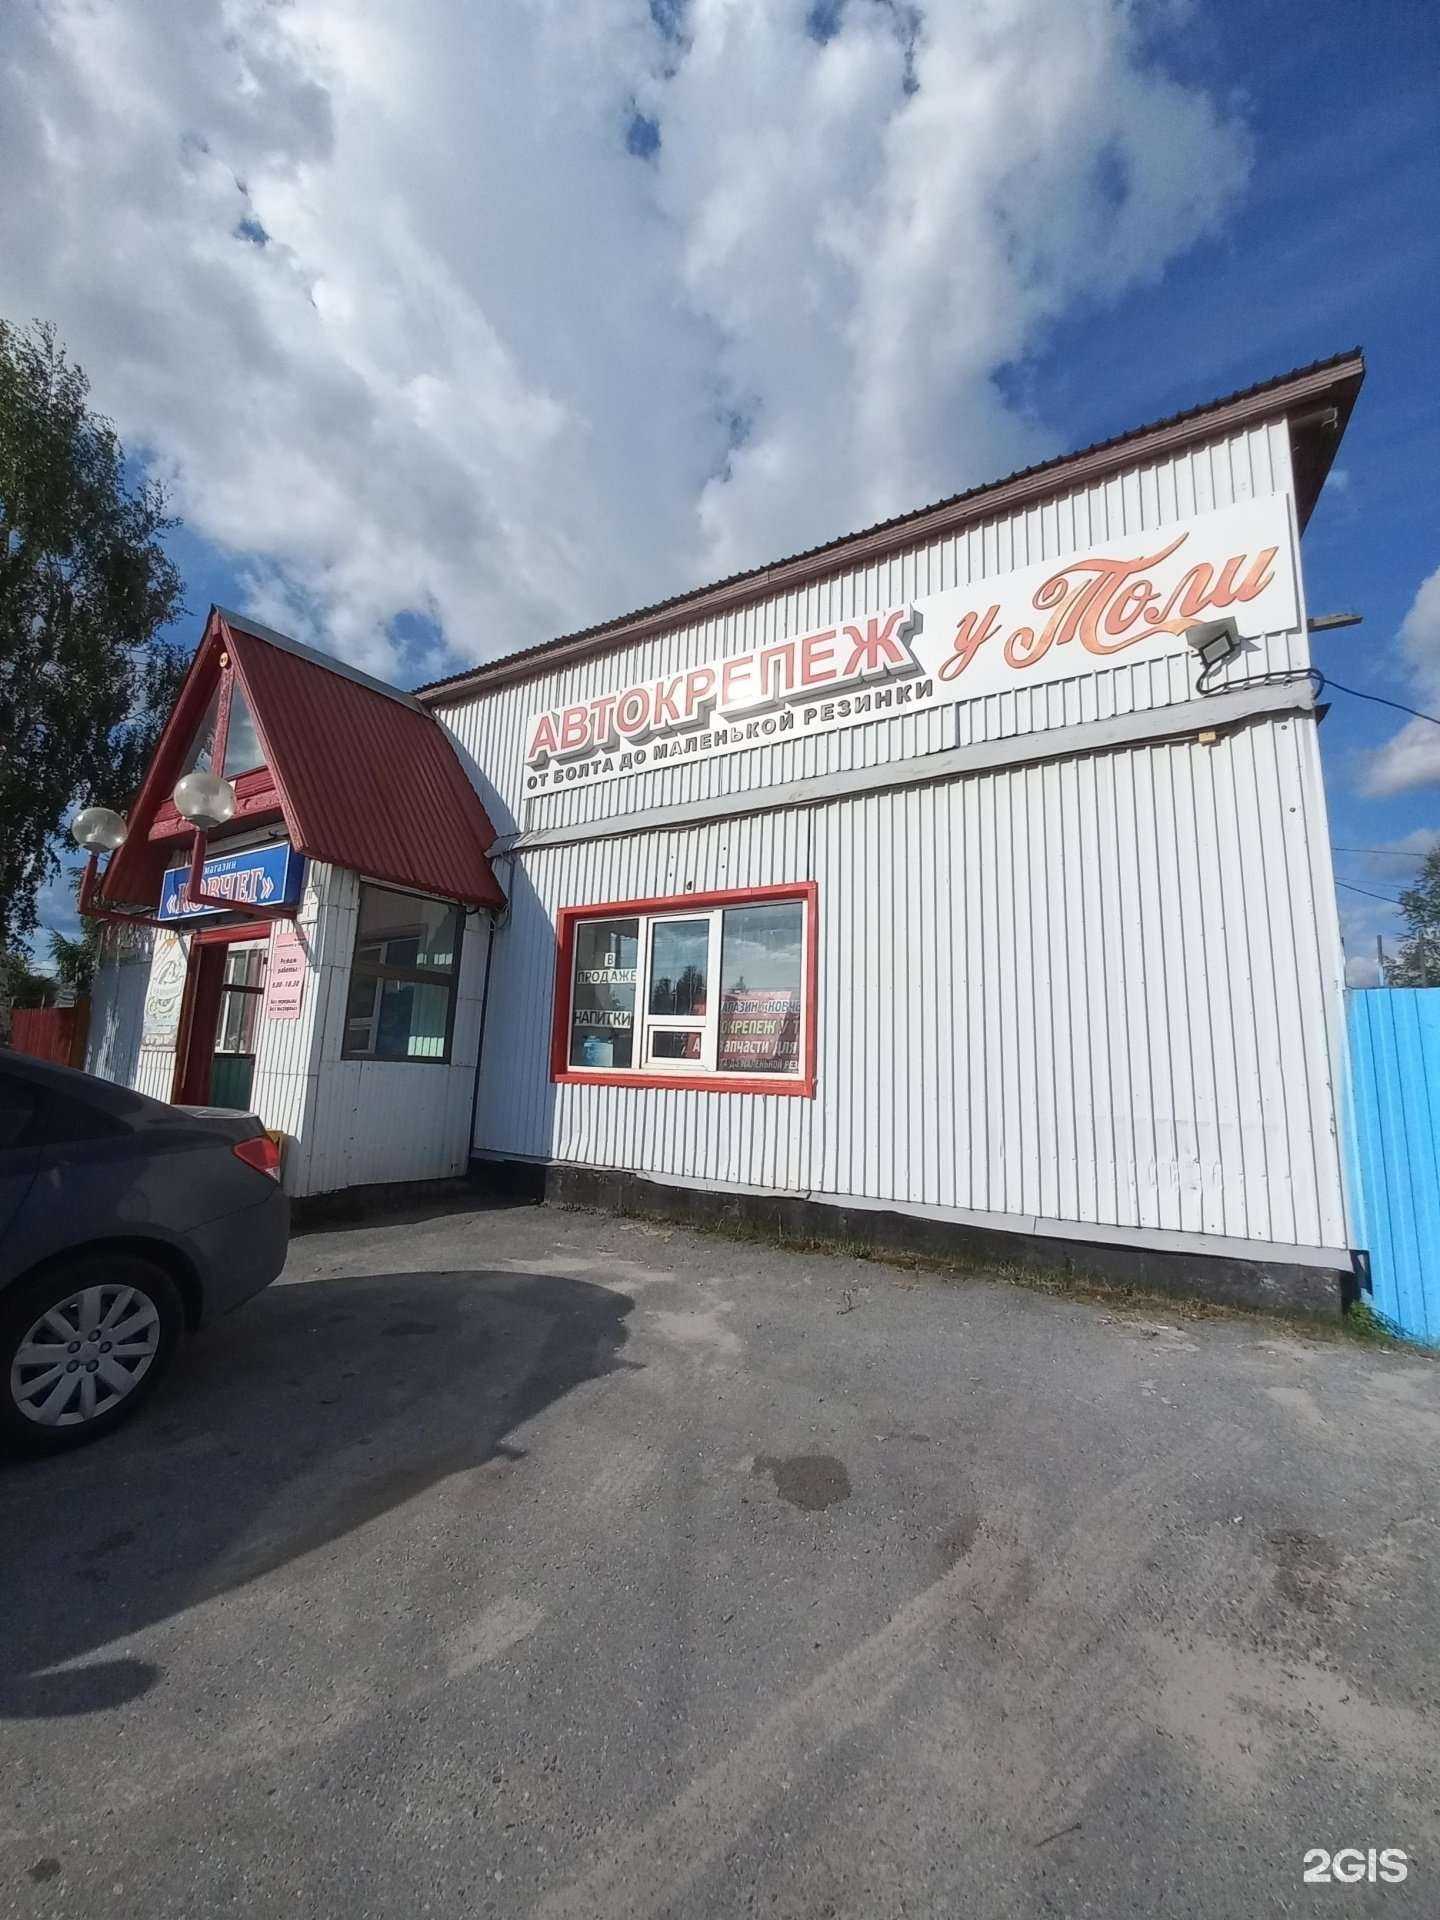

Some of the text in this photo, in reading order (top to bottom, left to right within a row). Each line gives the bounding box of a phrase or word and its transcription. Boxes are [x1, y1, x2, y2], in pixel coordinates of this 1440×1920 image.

[1004, 531, 1280, 669] Толи
[527, 608, 906, 760] АВТОКРЕПЕЖ
[527, 678, 933, 790] ОТ БОЛТА ДО МАЛЕНЬКОЙ РЕЗИНКИ
[204, 860, 237, 874] магазин
[607, 954, 614, 965] В
[577, 970, 636, 984] ПРОДАЖЕ
[721, 1001, 758, 1013] АГАЗИН
[575, 1011, 630, 1026] НАПИТКИ
